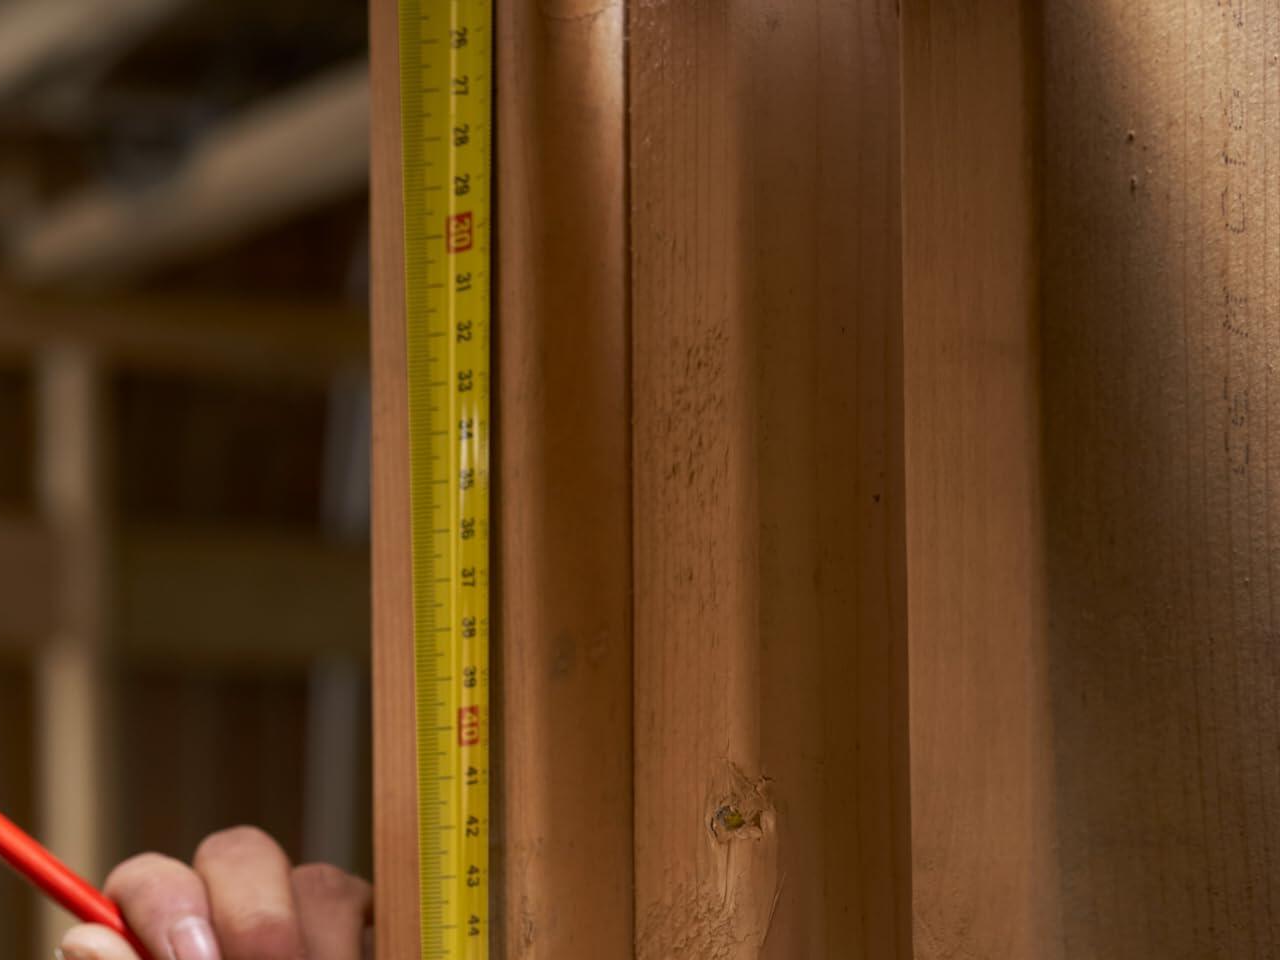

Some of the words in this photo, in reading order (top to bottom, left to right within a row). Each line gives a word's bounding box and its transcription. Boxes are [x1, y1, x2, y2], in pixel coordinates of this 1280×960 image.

[449, 27, 468, 49] 26
[450, 75, 469, 96] 27
[453, 124, 469, 147] 28
[454, 173, 470, 196] 29
[456, 272, 472, 292] 31
[457, 320, 472, 343] 32
[458, 369, 473, 392] 33
[461, 518, 475, 540] 36
[462, 566, 476, 587] 37
[462, 616, 476, 638] 38
[463, 666, 477, 688] 39
[465, 766, 479, 786] 41
[465, 816, 479, 838] 42
[466, 865, 480, 888] 43
[467, 915, 480, 937] 44
